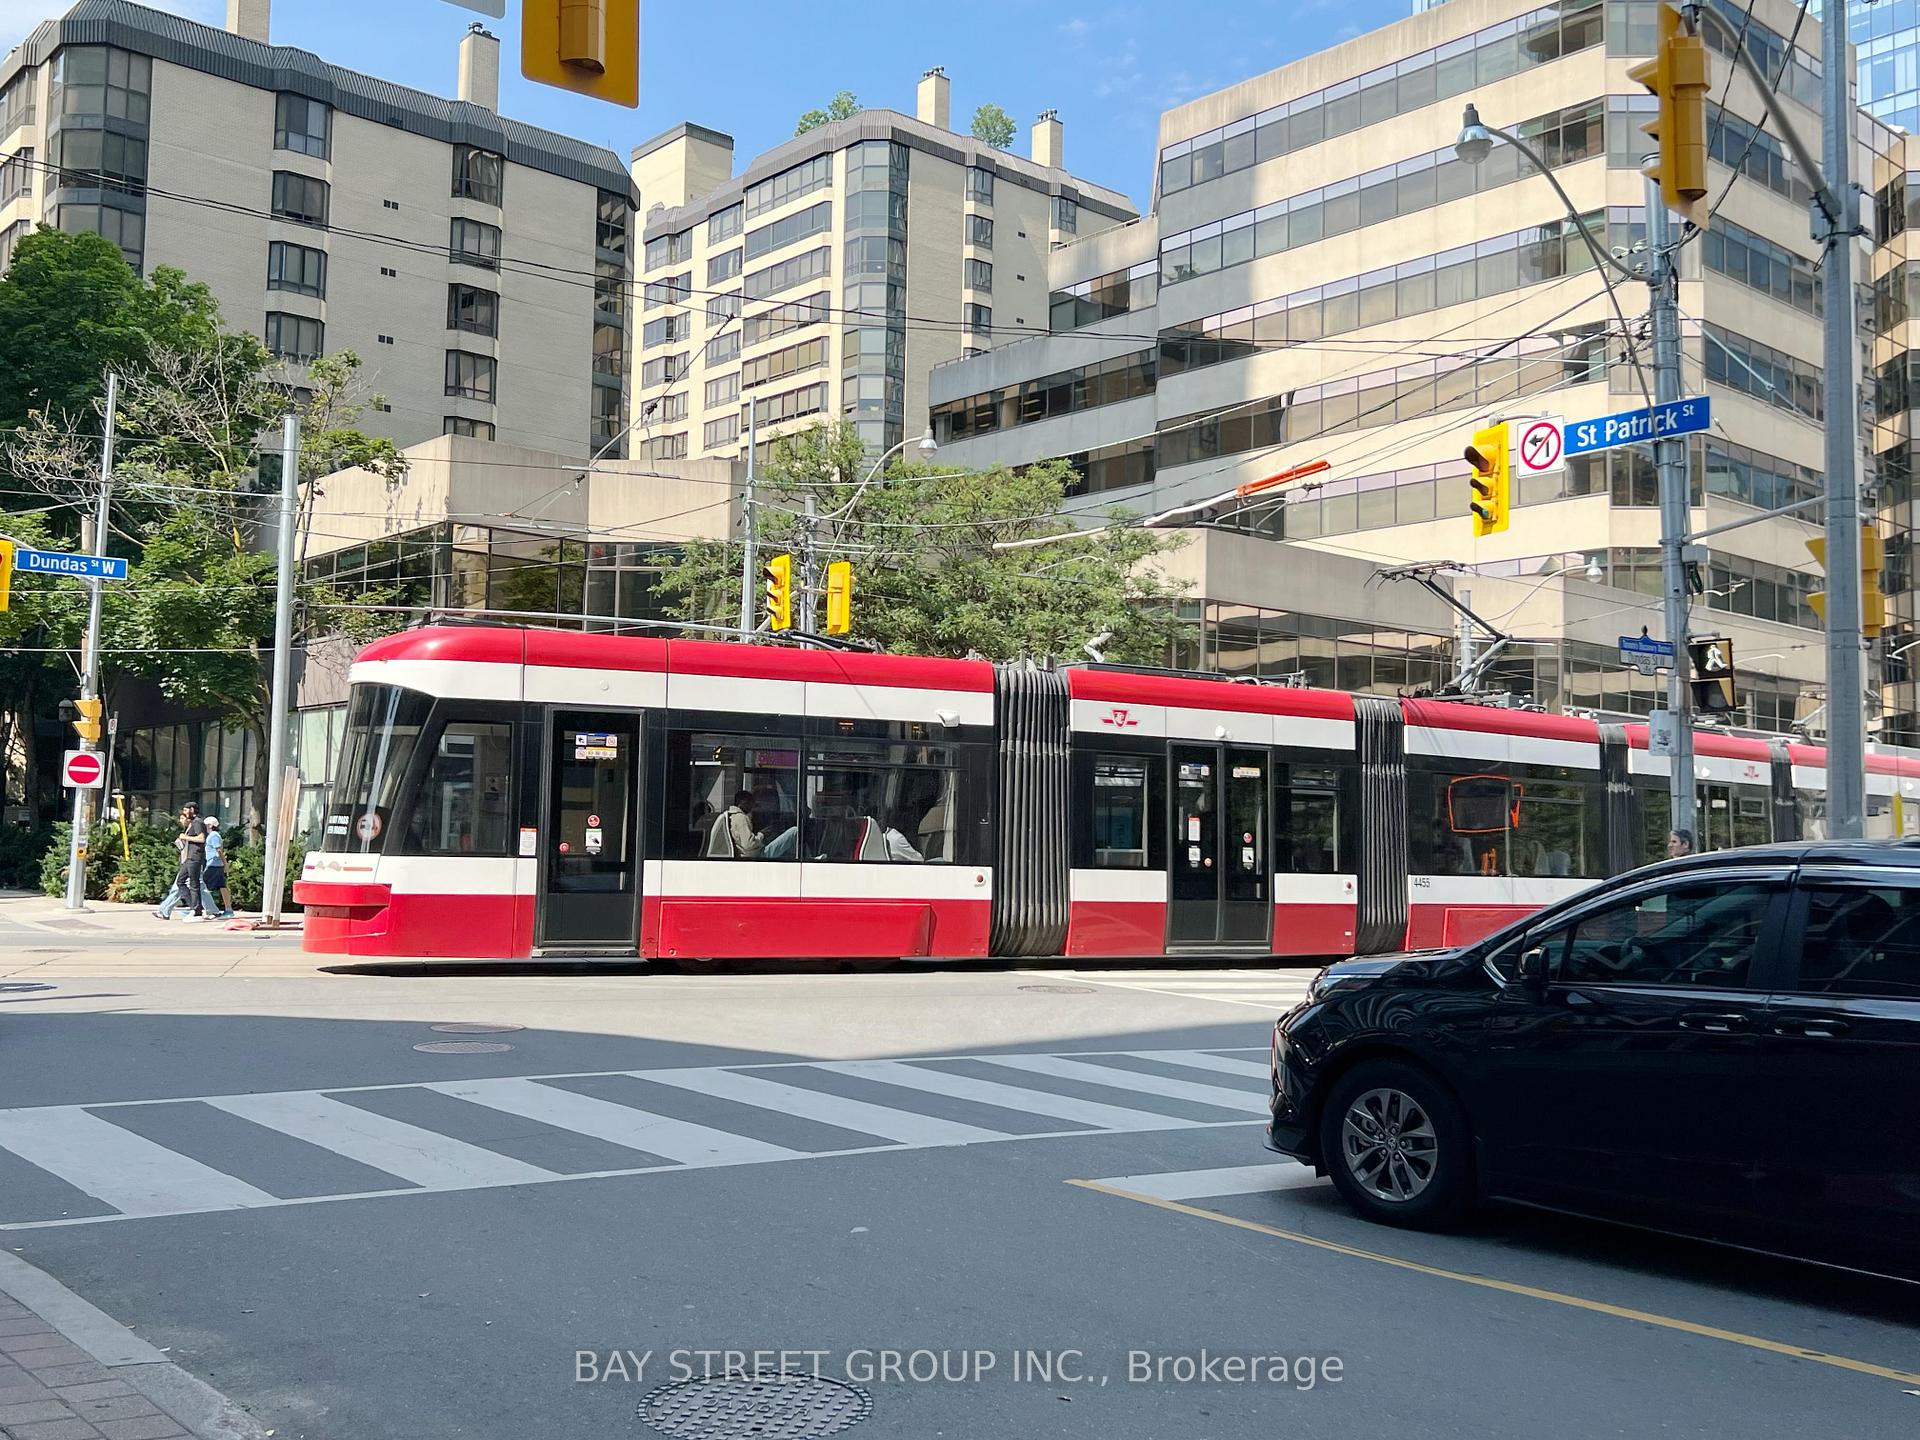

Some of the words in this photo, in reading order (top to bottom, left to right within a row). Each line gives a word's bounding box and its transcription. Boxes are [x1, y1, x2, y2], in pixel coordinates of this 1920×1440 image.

[1576, 424, 1597, 447] St
[1605, 408, 1678, 442] Patrick
[1682, 404, 1695, 417] St
[29, 553, 88, 572] Dundas
[91, 559, 100, 568] St
[102, 561, 116, 575] W
[1413, 877, 1431, 888] 4455
